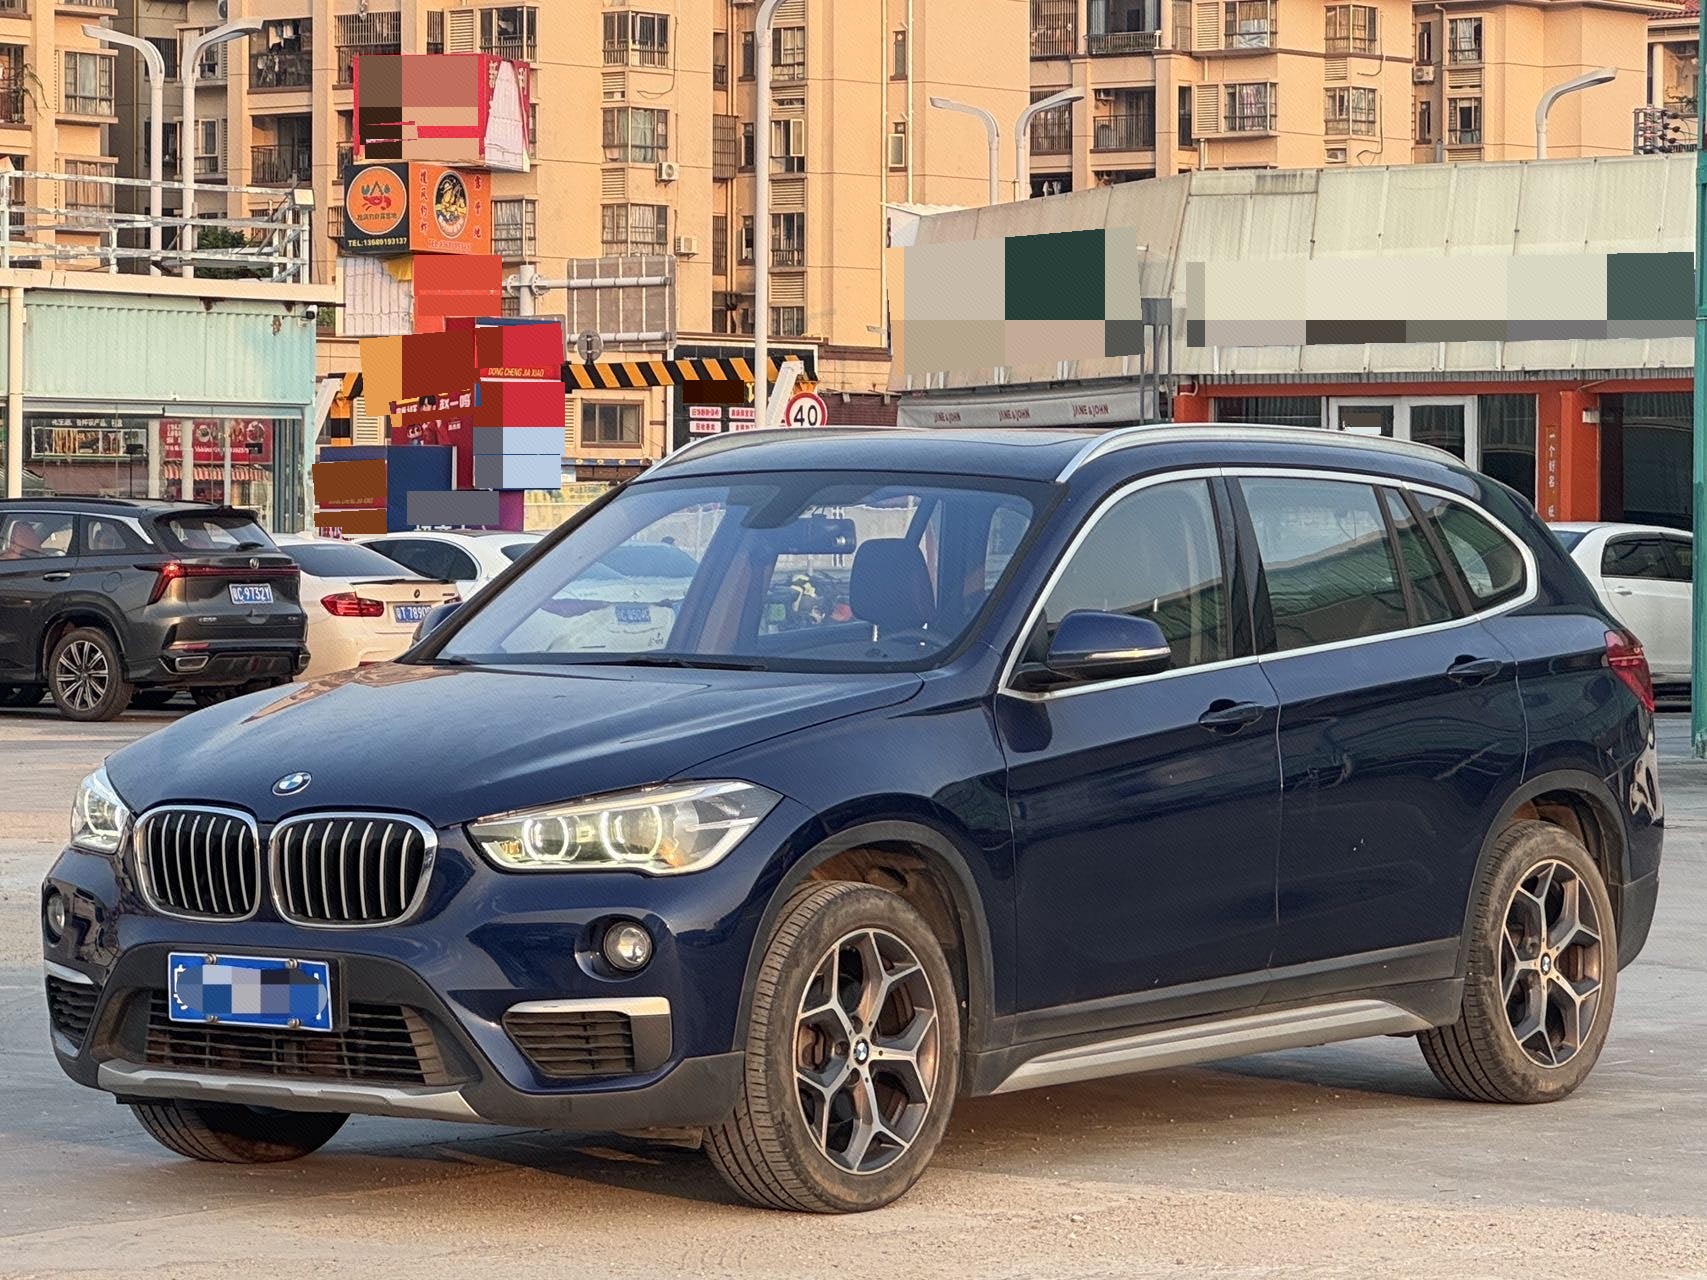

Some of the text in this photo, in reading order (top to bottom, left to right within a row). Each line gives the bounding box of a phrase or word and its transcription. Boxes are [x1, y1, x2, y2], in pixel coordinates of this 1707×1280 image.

[488, 367, 504, 376] DONG
[504, 367, 523, 377] CHENG
[531, 368, 545, 377] XIAO
[793, 404, 818, 426] 40
